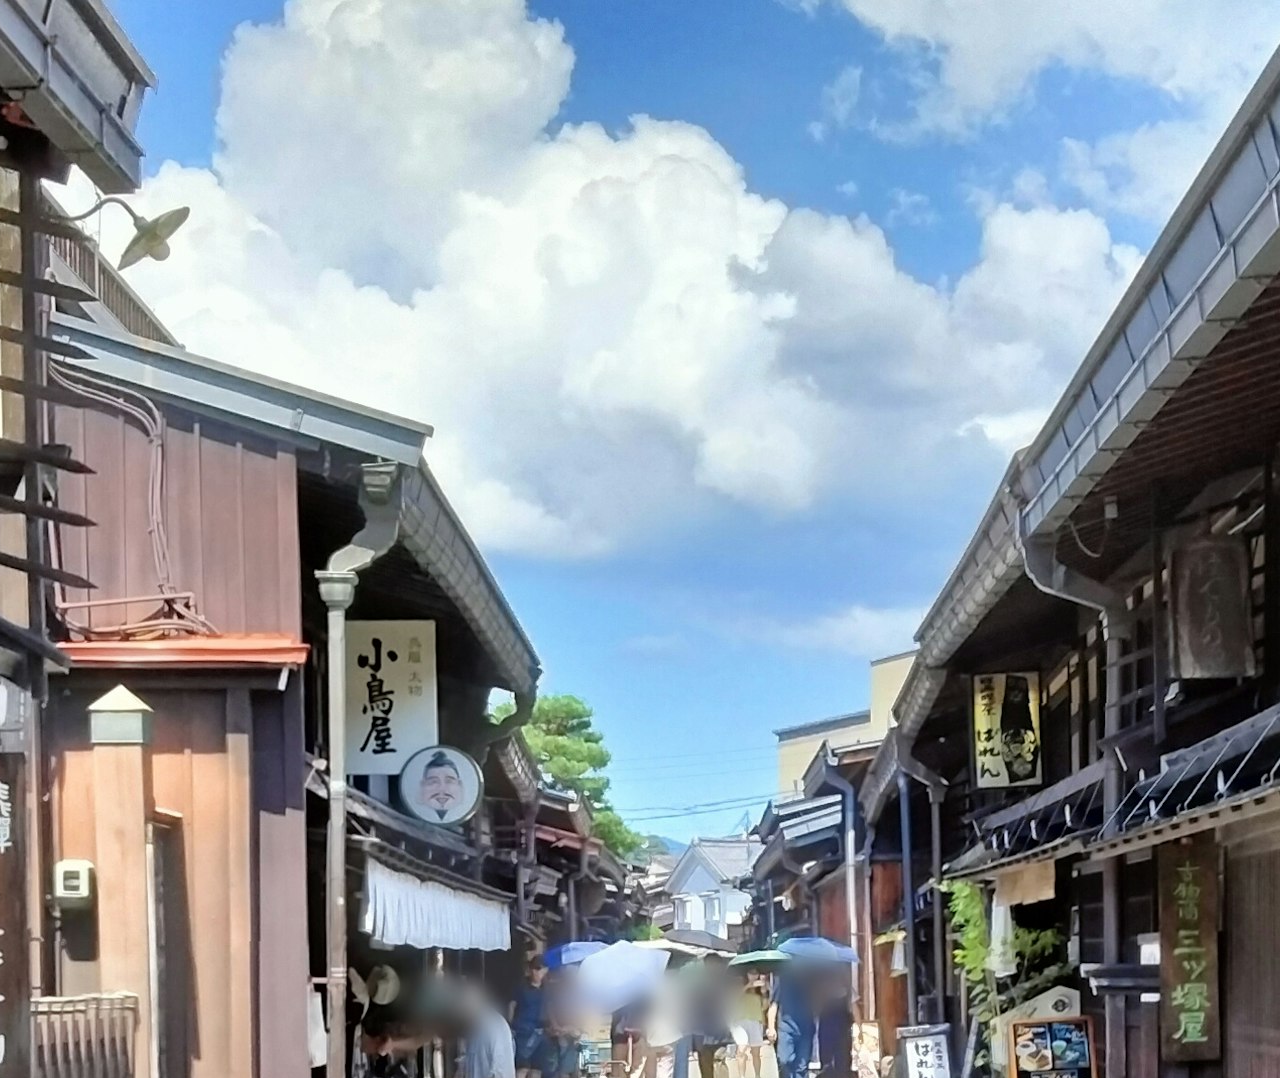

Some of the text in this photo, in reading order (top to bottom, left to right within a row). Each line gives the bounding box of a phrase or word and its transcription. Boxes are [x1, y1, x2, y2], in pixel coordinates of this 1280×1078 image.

[357, 637, 399, 755] 小鳥屋
[977, 728, 1001, 779] ばれん
[1172, 929, 1211, 1044] 三ツ塚屋
